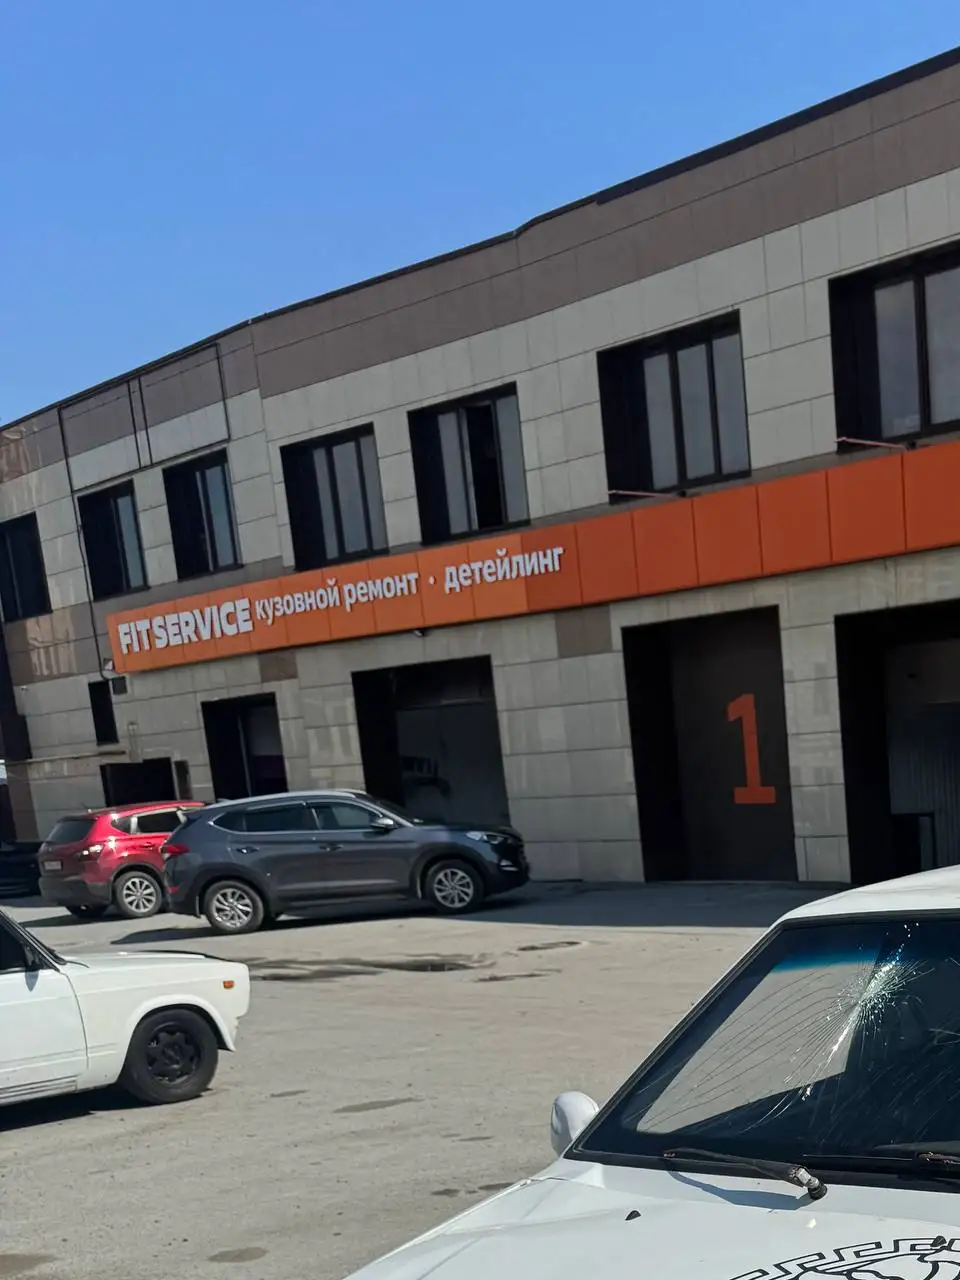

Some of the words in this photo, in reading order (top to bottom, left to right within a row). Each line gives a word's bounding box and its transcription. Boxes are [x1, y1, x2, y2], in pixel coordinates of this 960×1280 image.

[255, 577, 341, 626] кузовной
[342, 572, 419, 612] ремонт
[444, 547, 564, 595] детейлинг
[726, 693, 777, 804] 1
